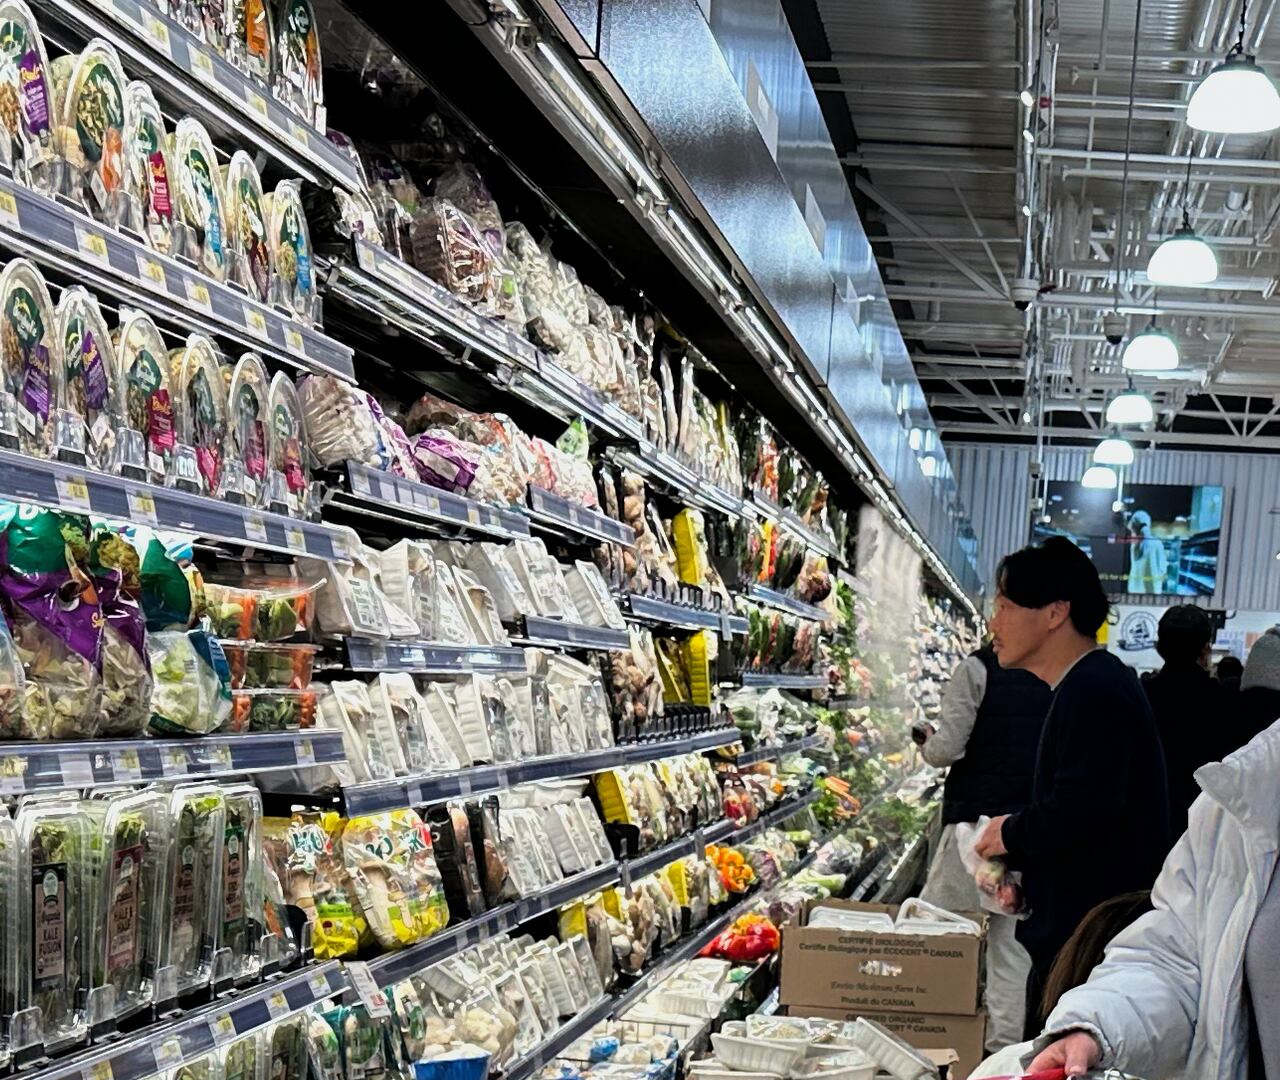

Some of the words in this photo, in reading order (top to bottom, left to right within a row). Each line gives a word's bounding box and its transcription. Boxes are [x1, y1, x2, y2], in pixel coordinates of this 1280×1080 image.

[43, 927, 60, 942] KALE
[930, 949, 964, 959] CANADA
[870, 997, 881, 1006] du
[882, 997, 916, 1008] CANADA
[889, 1014, 926, 1025] ORGANIC
[913, 1025, 947, 1035] CANADA
